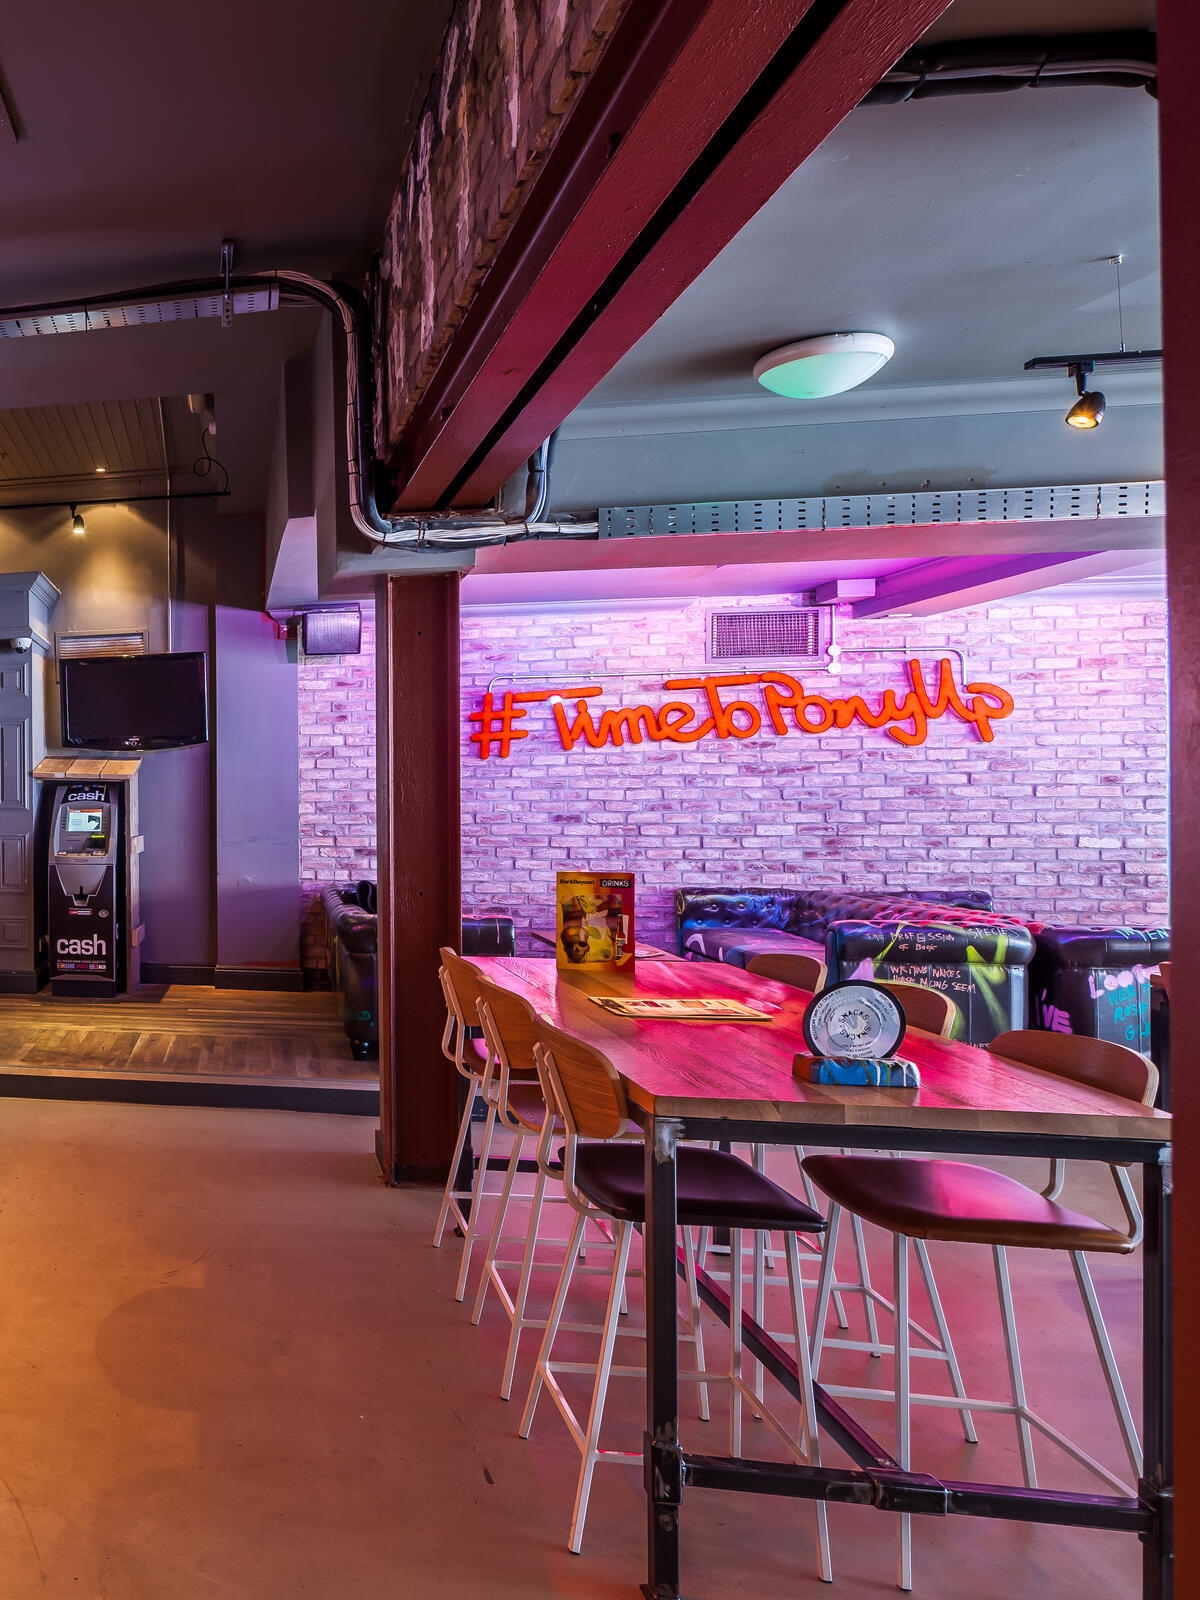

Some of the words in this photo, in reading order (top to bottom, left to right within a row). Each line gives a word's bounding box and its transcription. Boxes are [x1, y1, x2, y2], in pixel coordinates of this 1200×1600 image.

[469, 658, 1015, 759] #TimeToPonyUp
[67, 790, 105, 801] cash
[601, 879, 629, 888] DRINKS
[56, 933, 106, 956] cash
[951, 981, 977, 994] SEEM
[837, 1008, 870, 1023] SNACKS
[839, 1025, 872, 1041] SNACKS
